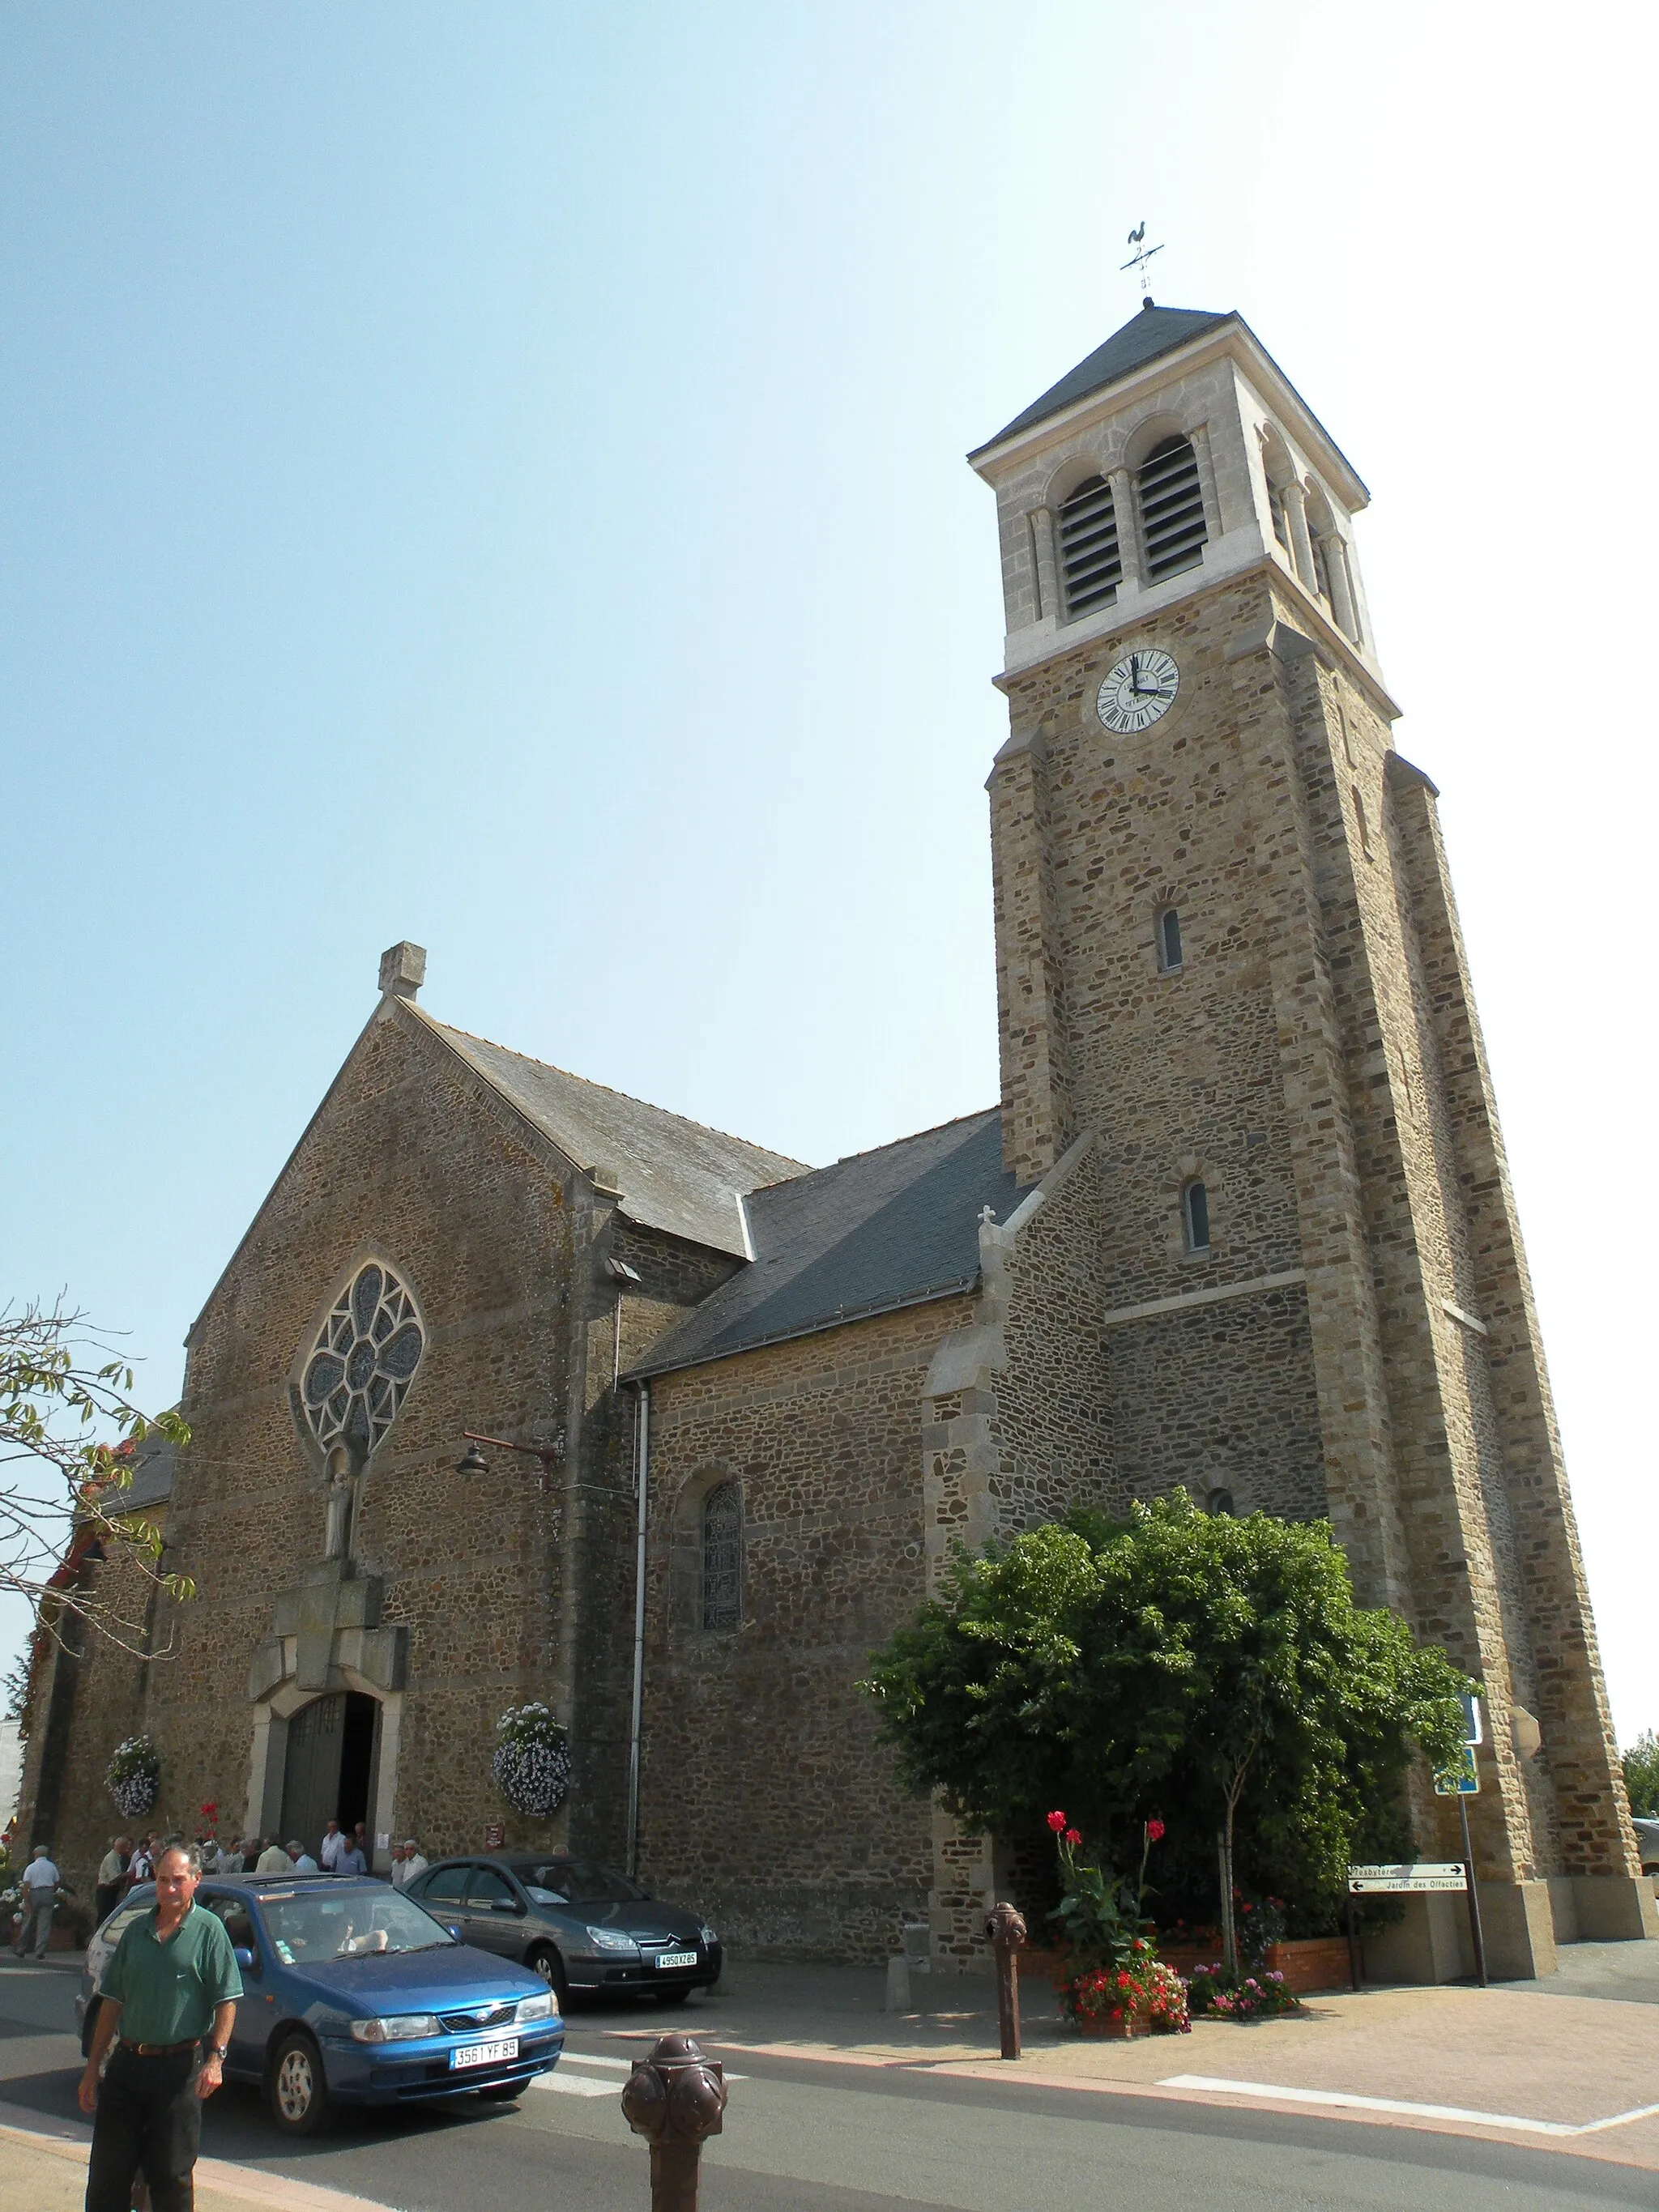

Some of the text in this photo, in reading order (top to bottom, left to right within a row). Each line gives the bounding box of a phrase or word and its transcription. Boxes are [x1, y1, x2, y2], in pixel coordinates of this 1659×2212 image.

[1387, 1881, 1410, 1890] Jardin
[1430, 1880, 1464, 1888] Olfacties
[662, 1956, 679, 1966] 4950
[457, 2047, 484, 2065] 3561
[487, 2044, 501, 2060] YF
